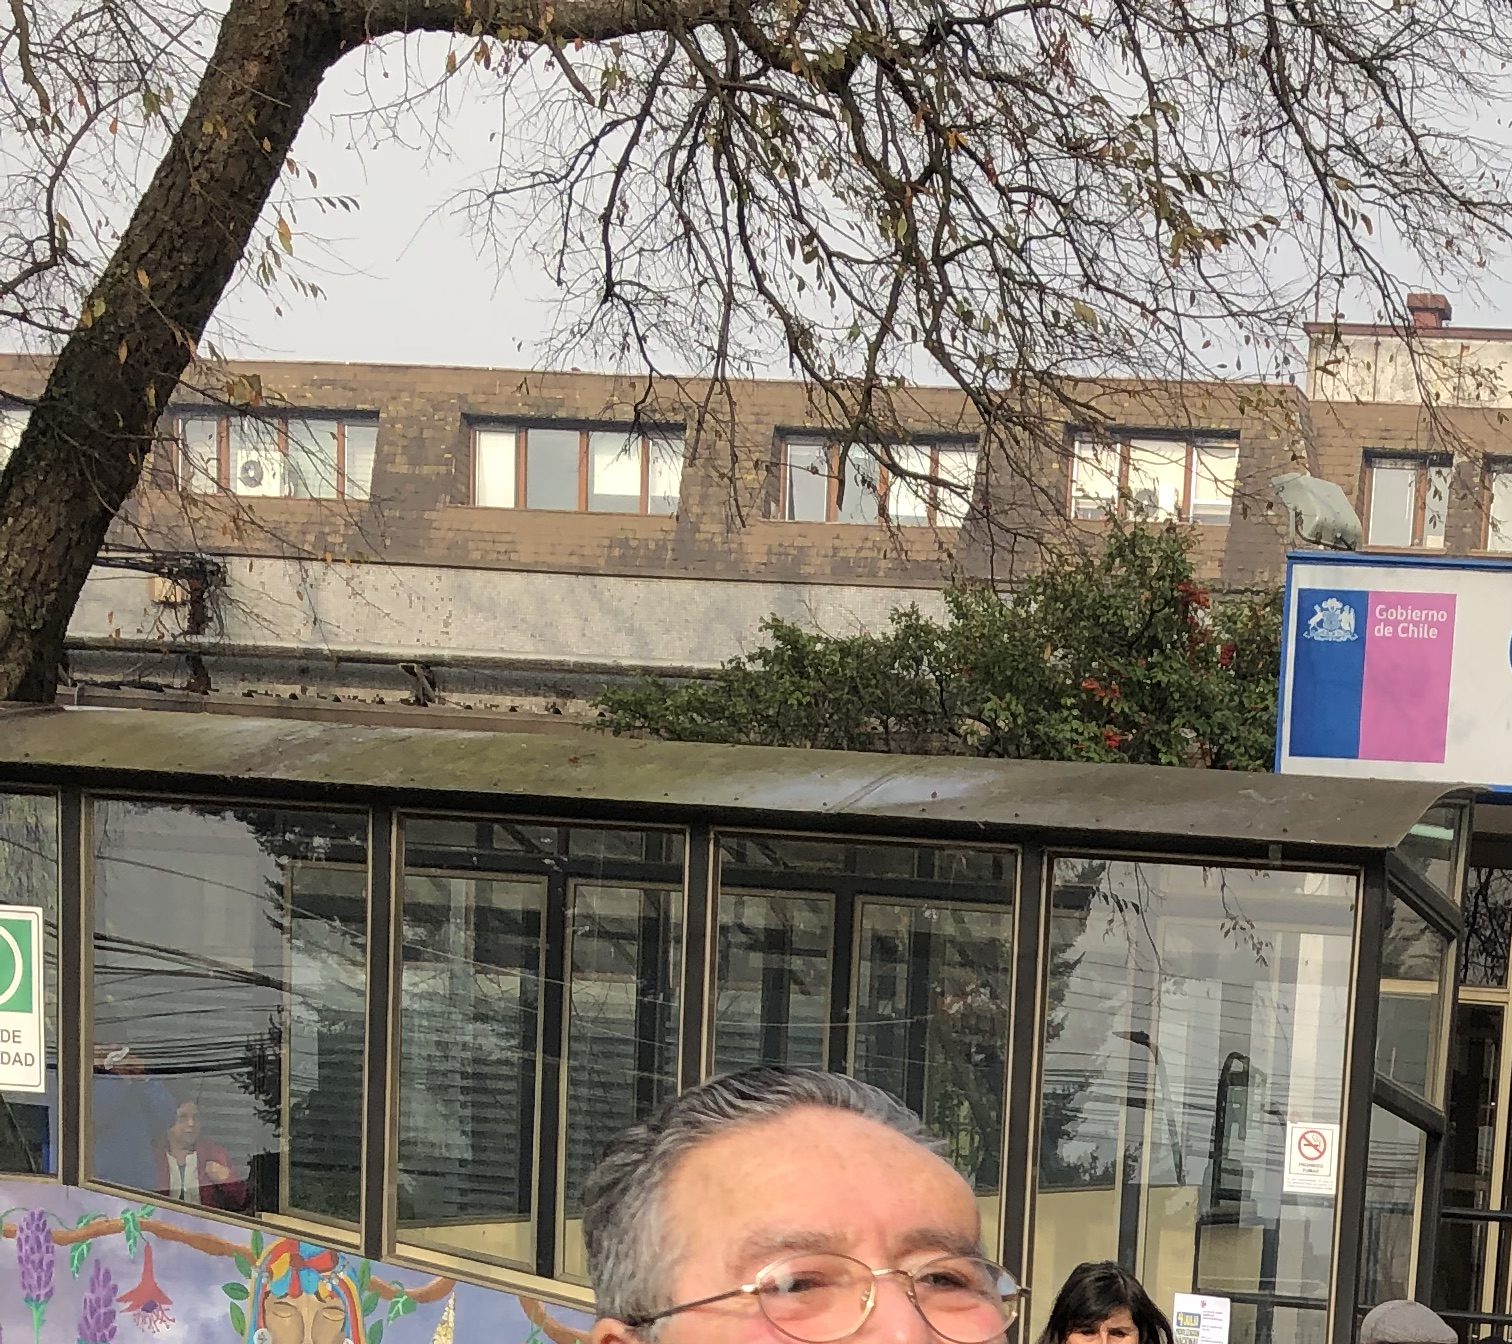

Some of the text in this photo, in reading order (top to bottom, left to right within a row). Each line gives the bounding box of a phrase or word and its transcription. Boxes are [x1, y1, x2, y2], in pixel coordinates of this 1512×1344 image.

[1375, 604, 1447, 622] Gobierno
[1374, 622, 1438, 638] de Chile
[0, 1028, 21, 1044] DE
